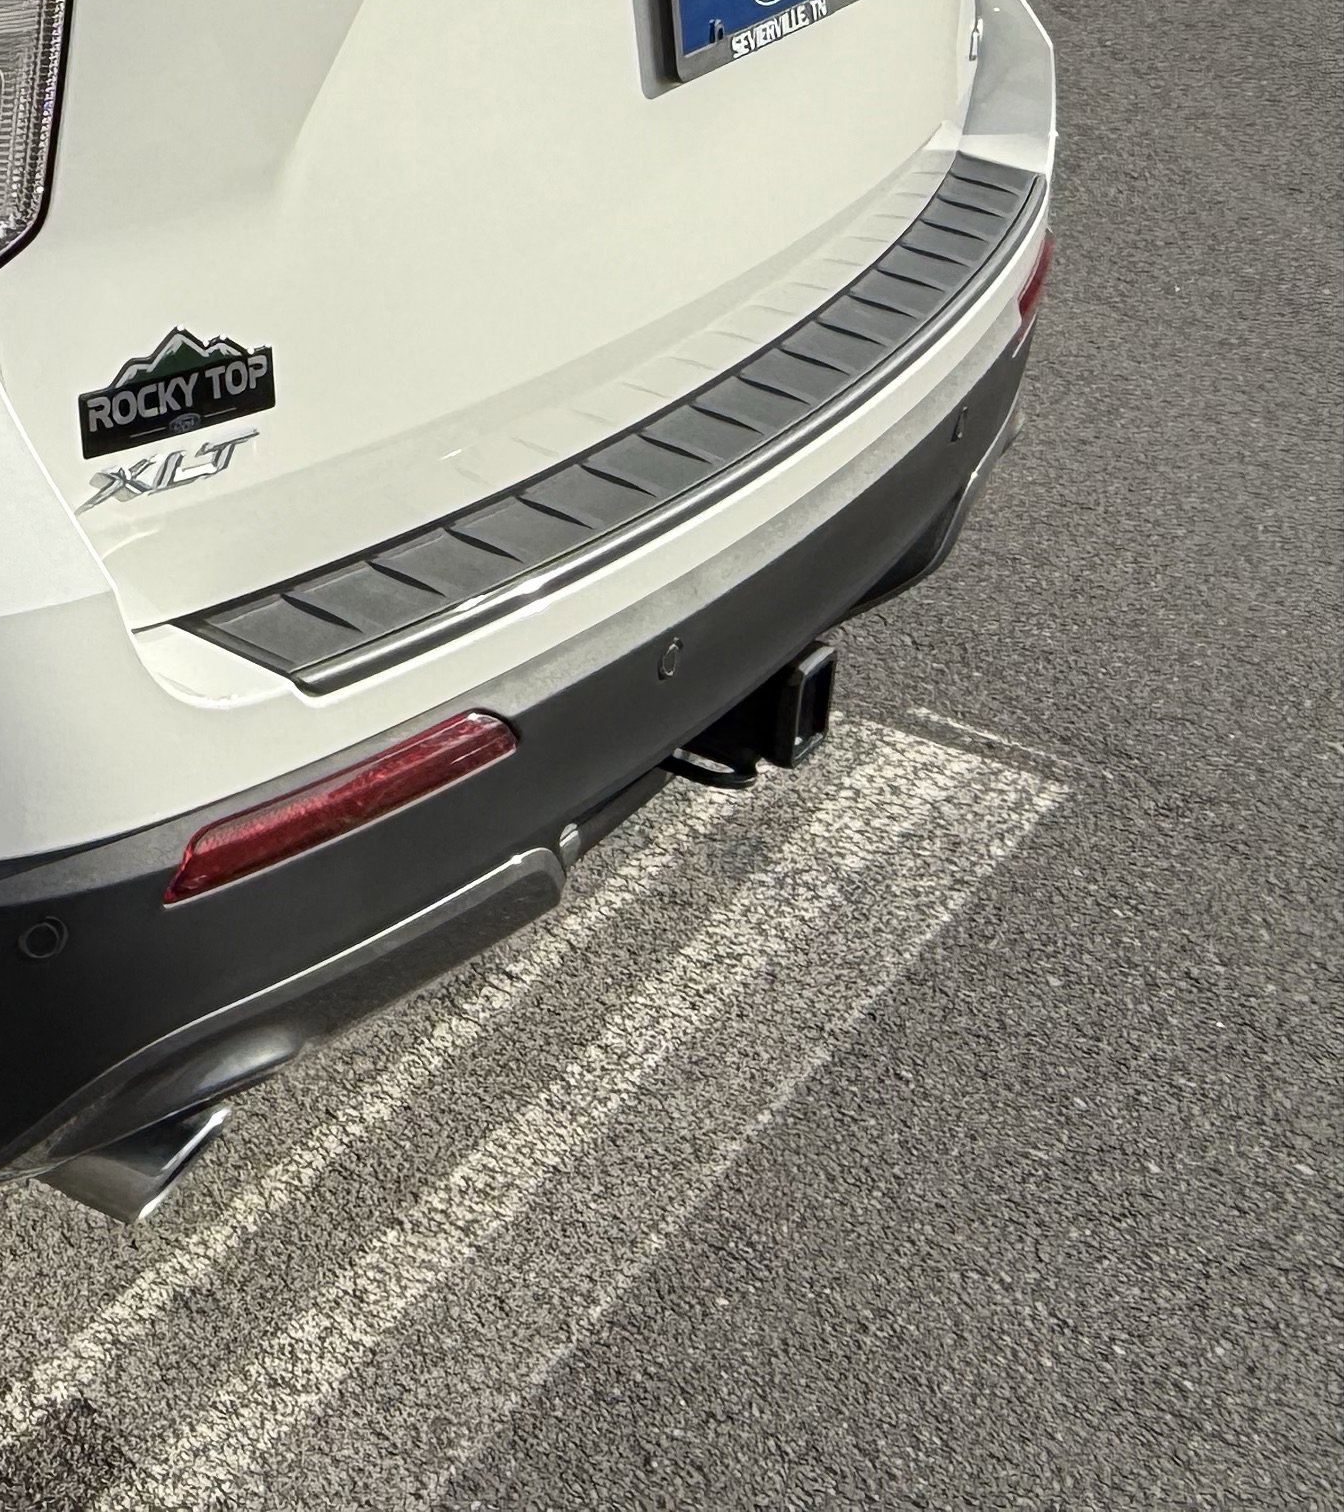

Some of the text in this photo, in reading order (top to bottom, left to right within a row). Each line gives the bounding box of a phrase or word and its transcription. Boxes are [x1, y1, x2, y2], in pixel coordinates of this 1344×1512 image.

[86, 354, 268, 432] ROCKY TOP
[74, 428, 260, 515] XLT
